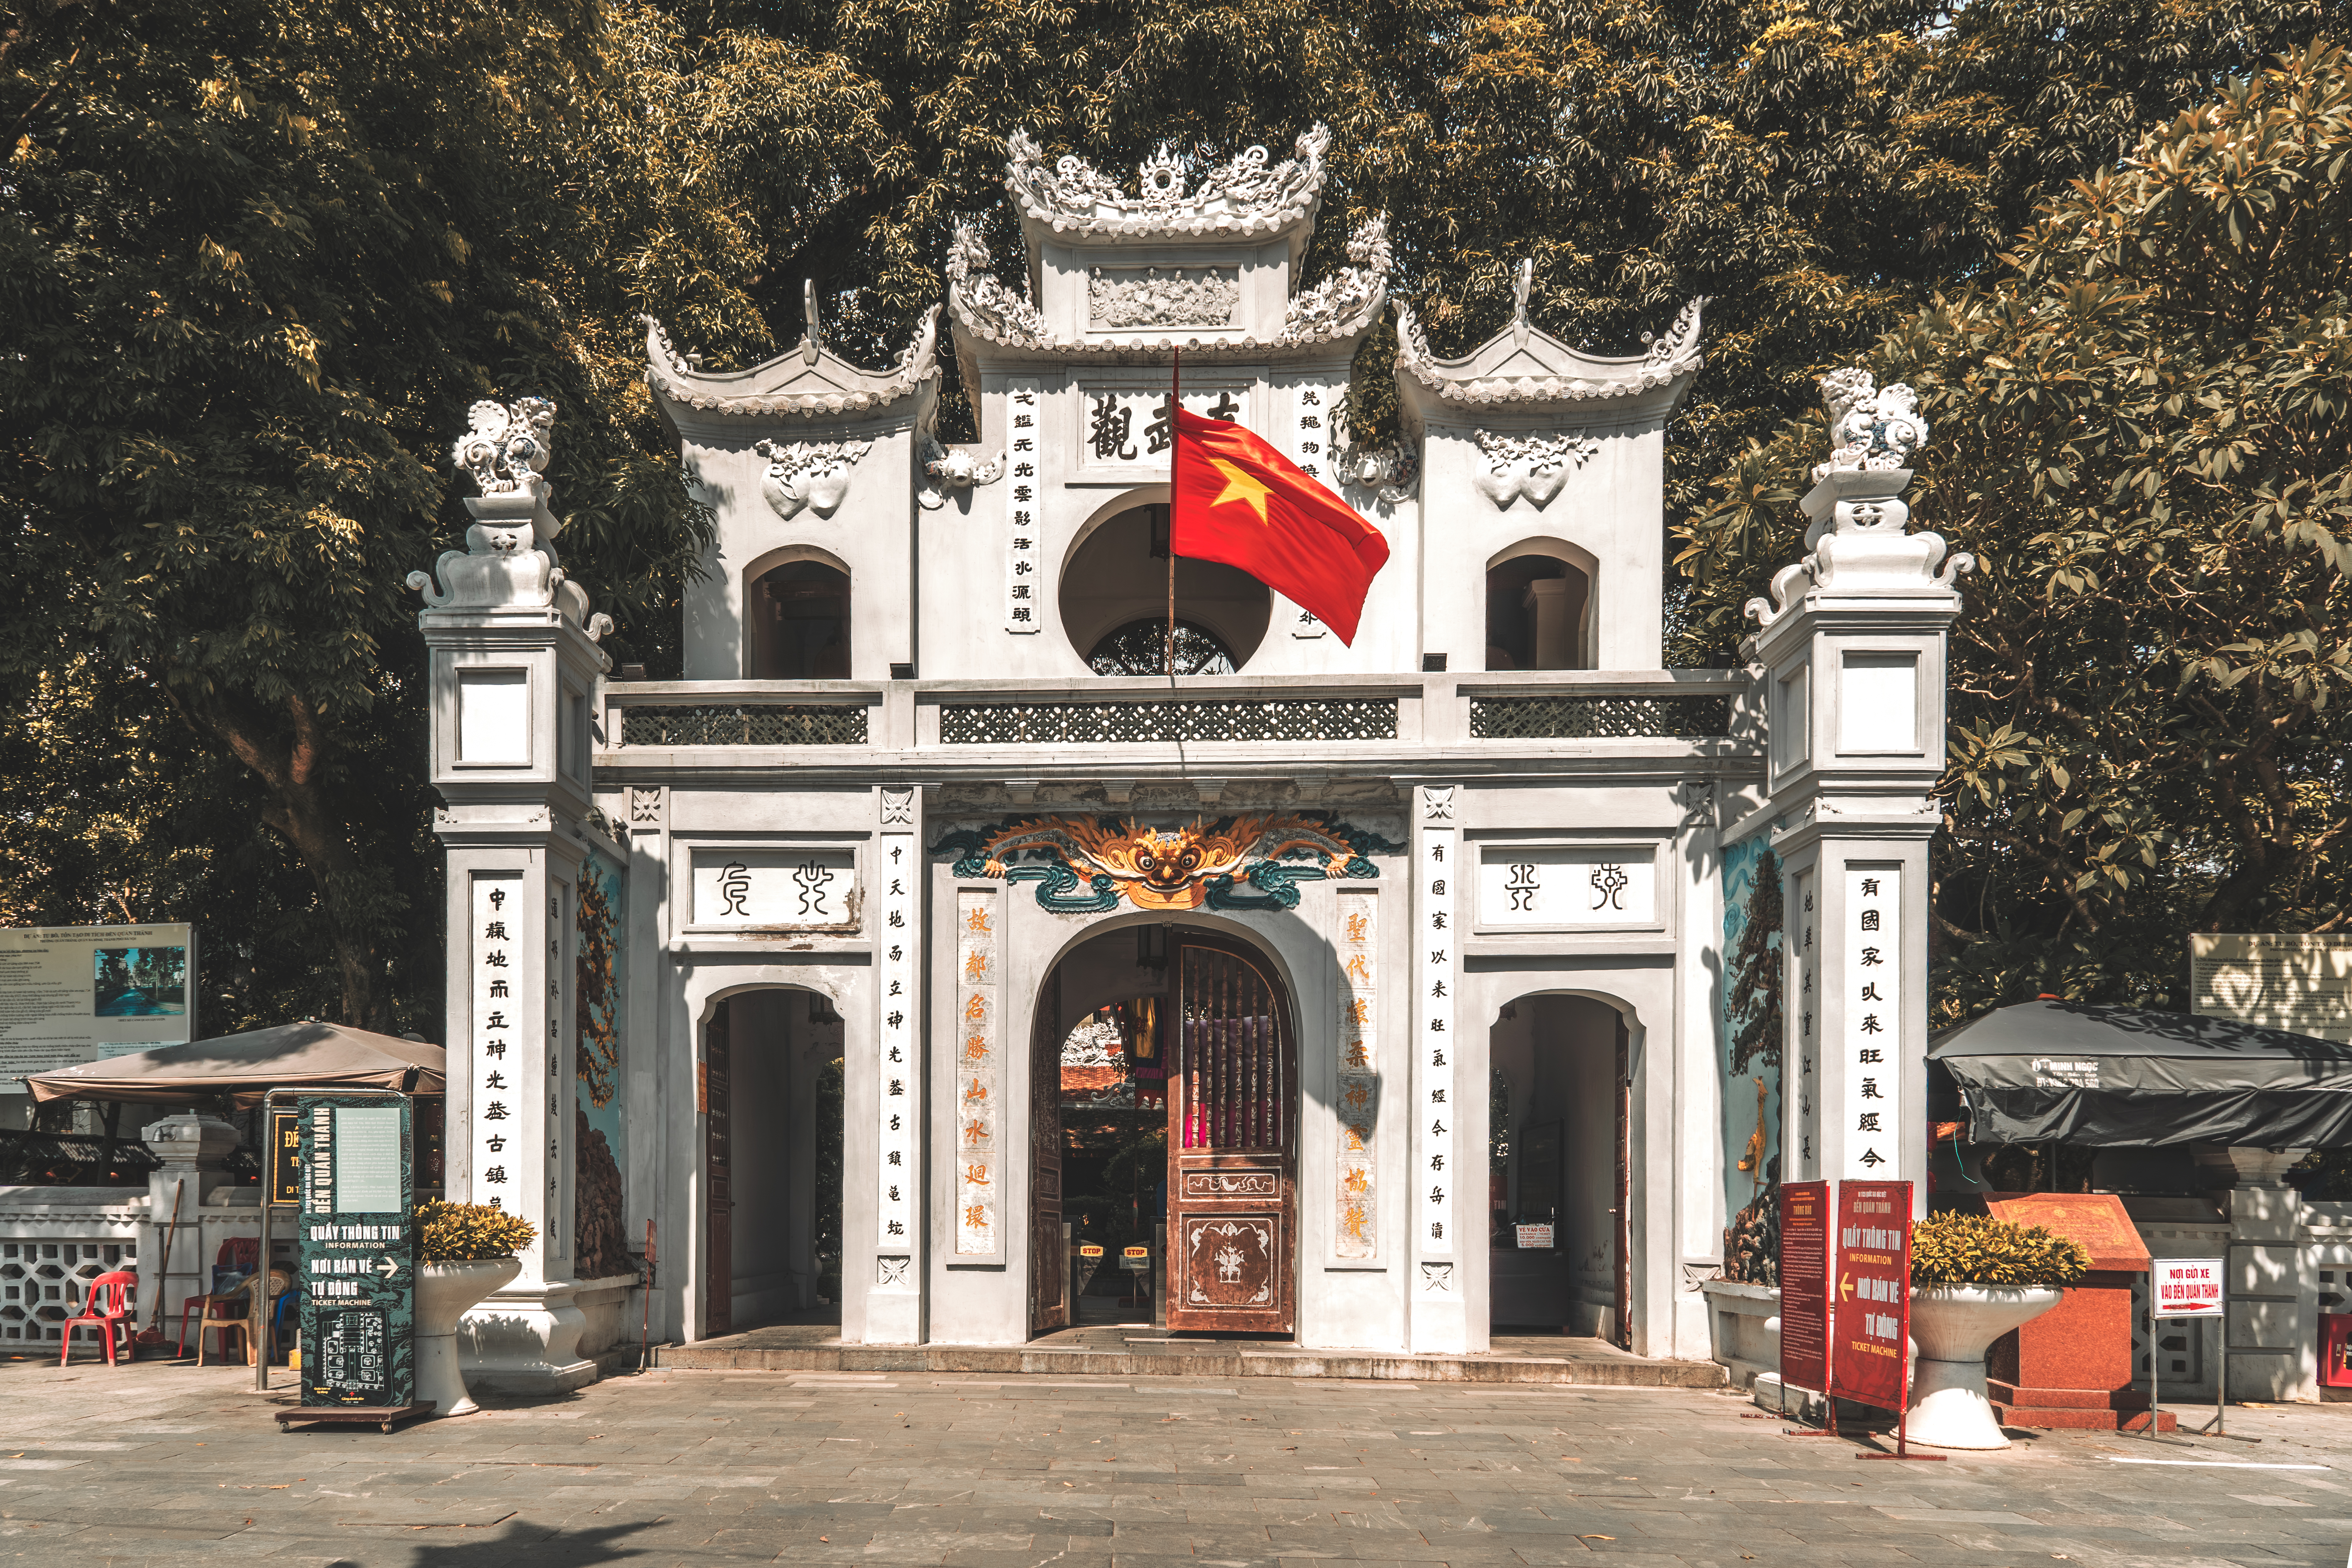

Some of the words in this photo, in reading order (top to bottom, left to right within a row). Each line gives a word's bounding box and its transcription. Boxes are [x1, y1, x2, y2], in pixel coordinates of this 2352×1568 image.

[2049, 1062, 2073, 1071] MINH
[2075, 1062, 2098, 1073] NGỌC
[311, 1108, 330, 1148] THÁNH
[312, 1152, 332, 1185] QUÁN
[311, 1190, 331, 1213] ĐỀN
[1853, 1198, 1862, 1213] ĐỀN
[1863, 1199, 1875, 1214] QUÁN
[1876, 1200, 1891, 1214] THÁNH
[310, 1222, 341, 1241] QUẦY
[341, 1223, 379, 1240] THÔNG
[381, 1225, 400, 1240] TIN
[1862, 1225, 1887, 1250] THÔNG
[1888, 1230, 1901, 1250] TIN
[311, 1259, 332, 1273] NƠI
[334, 1257, 357, 1273] BÁN
[358, 1257, 372, 1273] VÉ
[1849, 1253, 1892, 1265] INFORMATION
[2169, 1268, 2184, 1279] NƠI
[2186, 1264, 2198, 1279] GỬI
[2200, 1268, 2210, 1278] XE
[311, 1281, 325, 1299] TỰ
[328, 1279, 358, 1299] ĐỘNG
[1872, 1276, 1889, 1303] BÁN
[1889, 1278, 1899, 1304] VÉ
[2161, 1281, 2172, 1300] VÀO
[2173, 1279, 2184, 1299] ĐỀN
[2186, 1280, 2200, 1300] QUÁN
[2202, 1280, 2219, 1298] THÁNH
[1865, 1312, 1876, 1341] TỰ
[1876, 1312, 1898, 1343] ĐỘNG
[1852, 1341, 1871, 1352] TICKET
[1871, 1345, 1897, 1358] MACHINE
